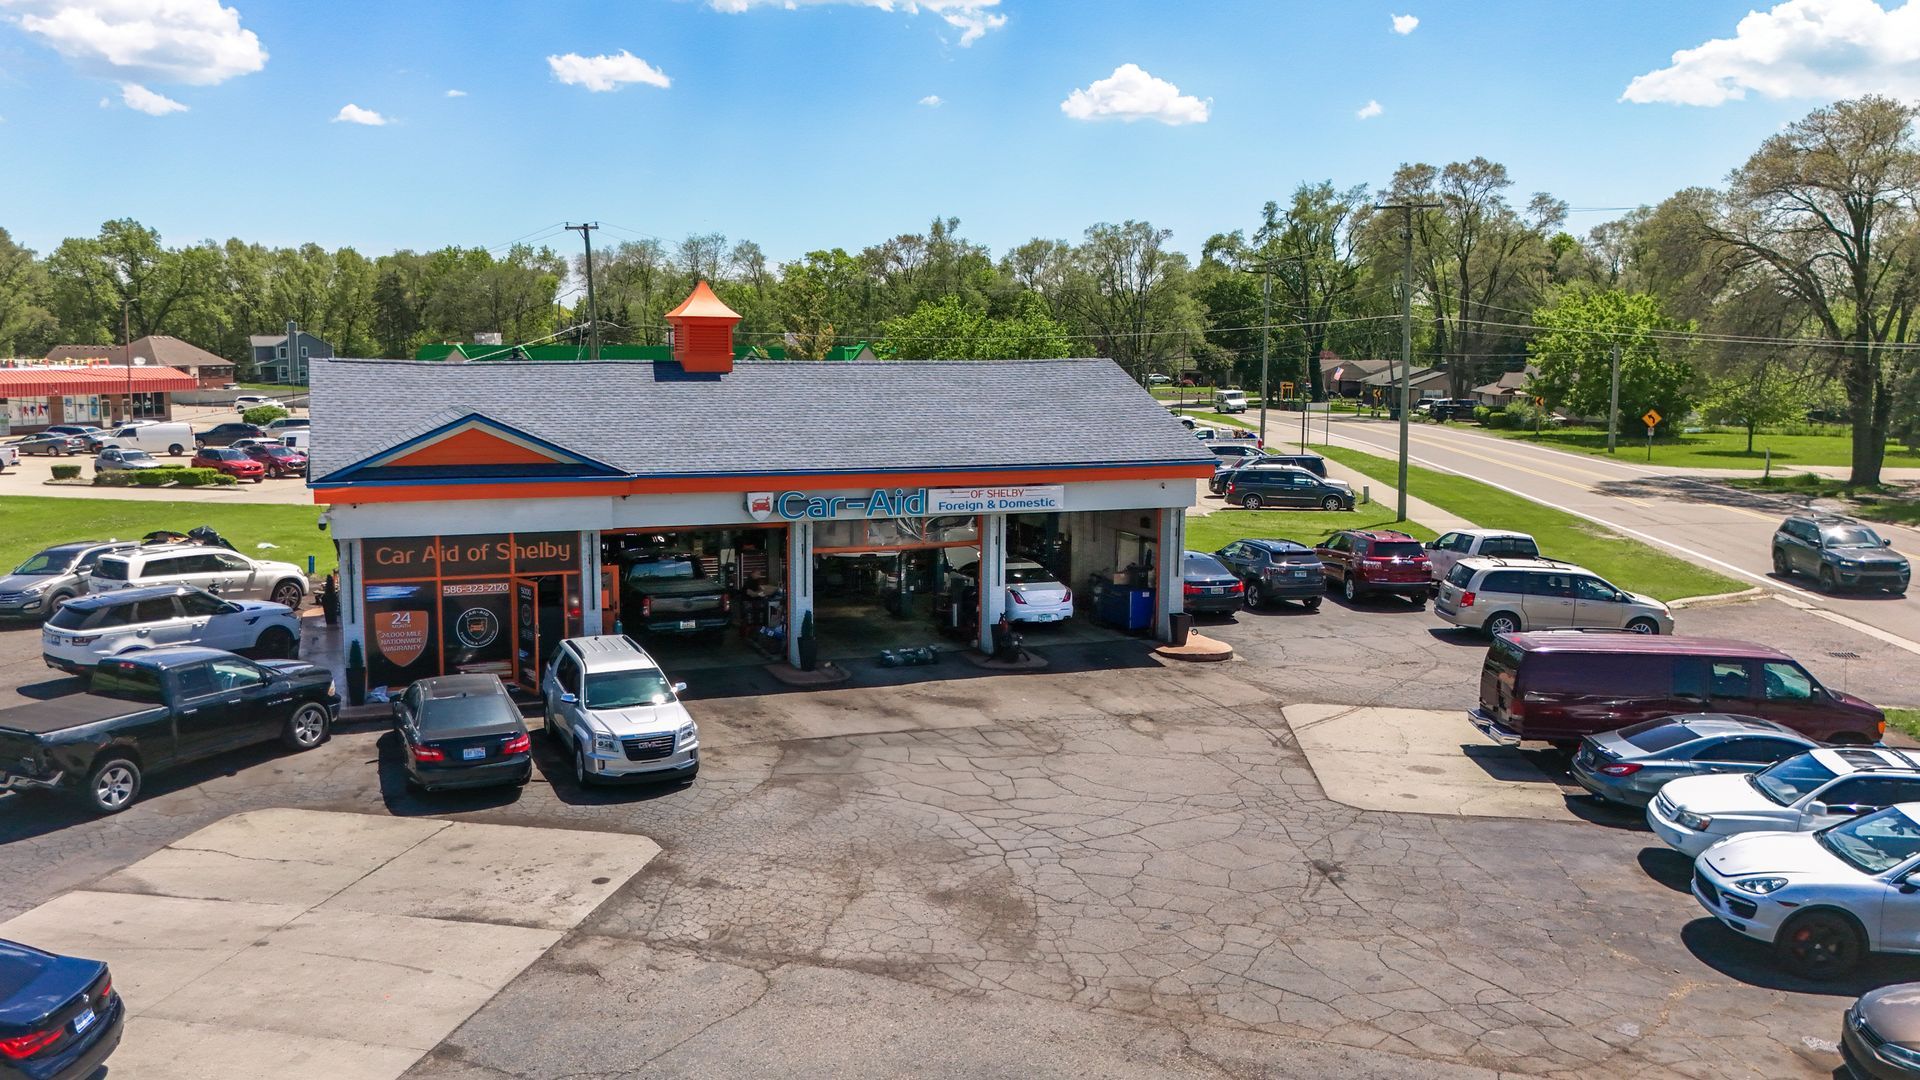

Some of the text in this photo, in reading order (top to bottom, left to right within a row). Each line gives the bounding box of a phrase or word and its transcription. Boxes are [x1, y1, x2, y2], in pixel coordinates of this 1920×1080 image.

[970, 488, 1025, 499] OF SHELBY
[777, 488, 927, 520] Car-Aid
[938, 497, 1056, 512] Foreign & Domestic
[376, 541, 570, 565] Car Aid of Shelby
[443, 583, 509, 594] 586-323-2120
[391, 612, 411, 625] 24
[381, 637, 422, 645] NATIONWIDE
[383, 644, 422, 652] WARRANTY
